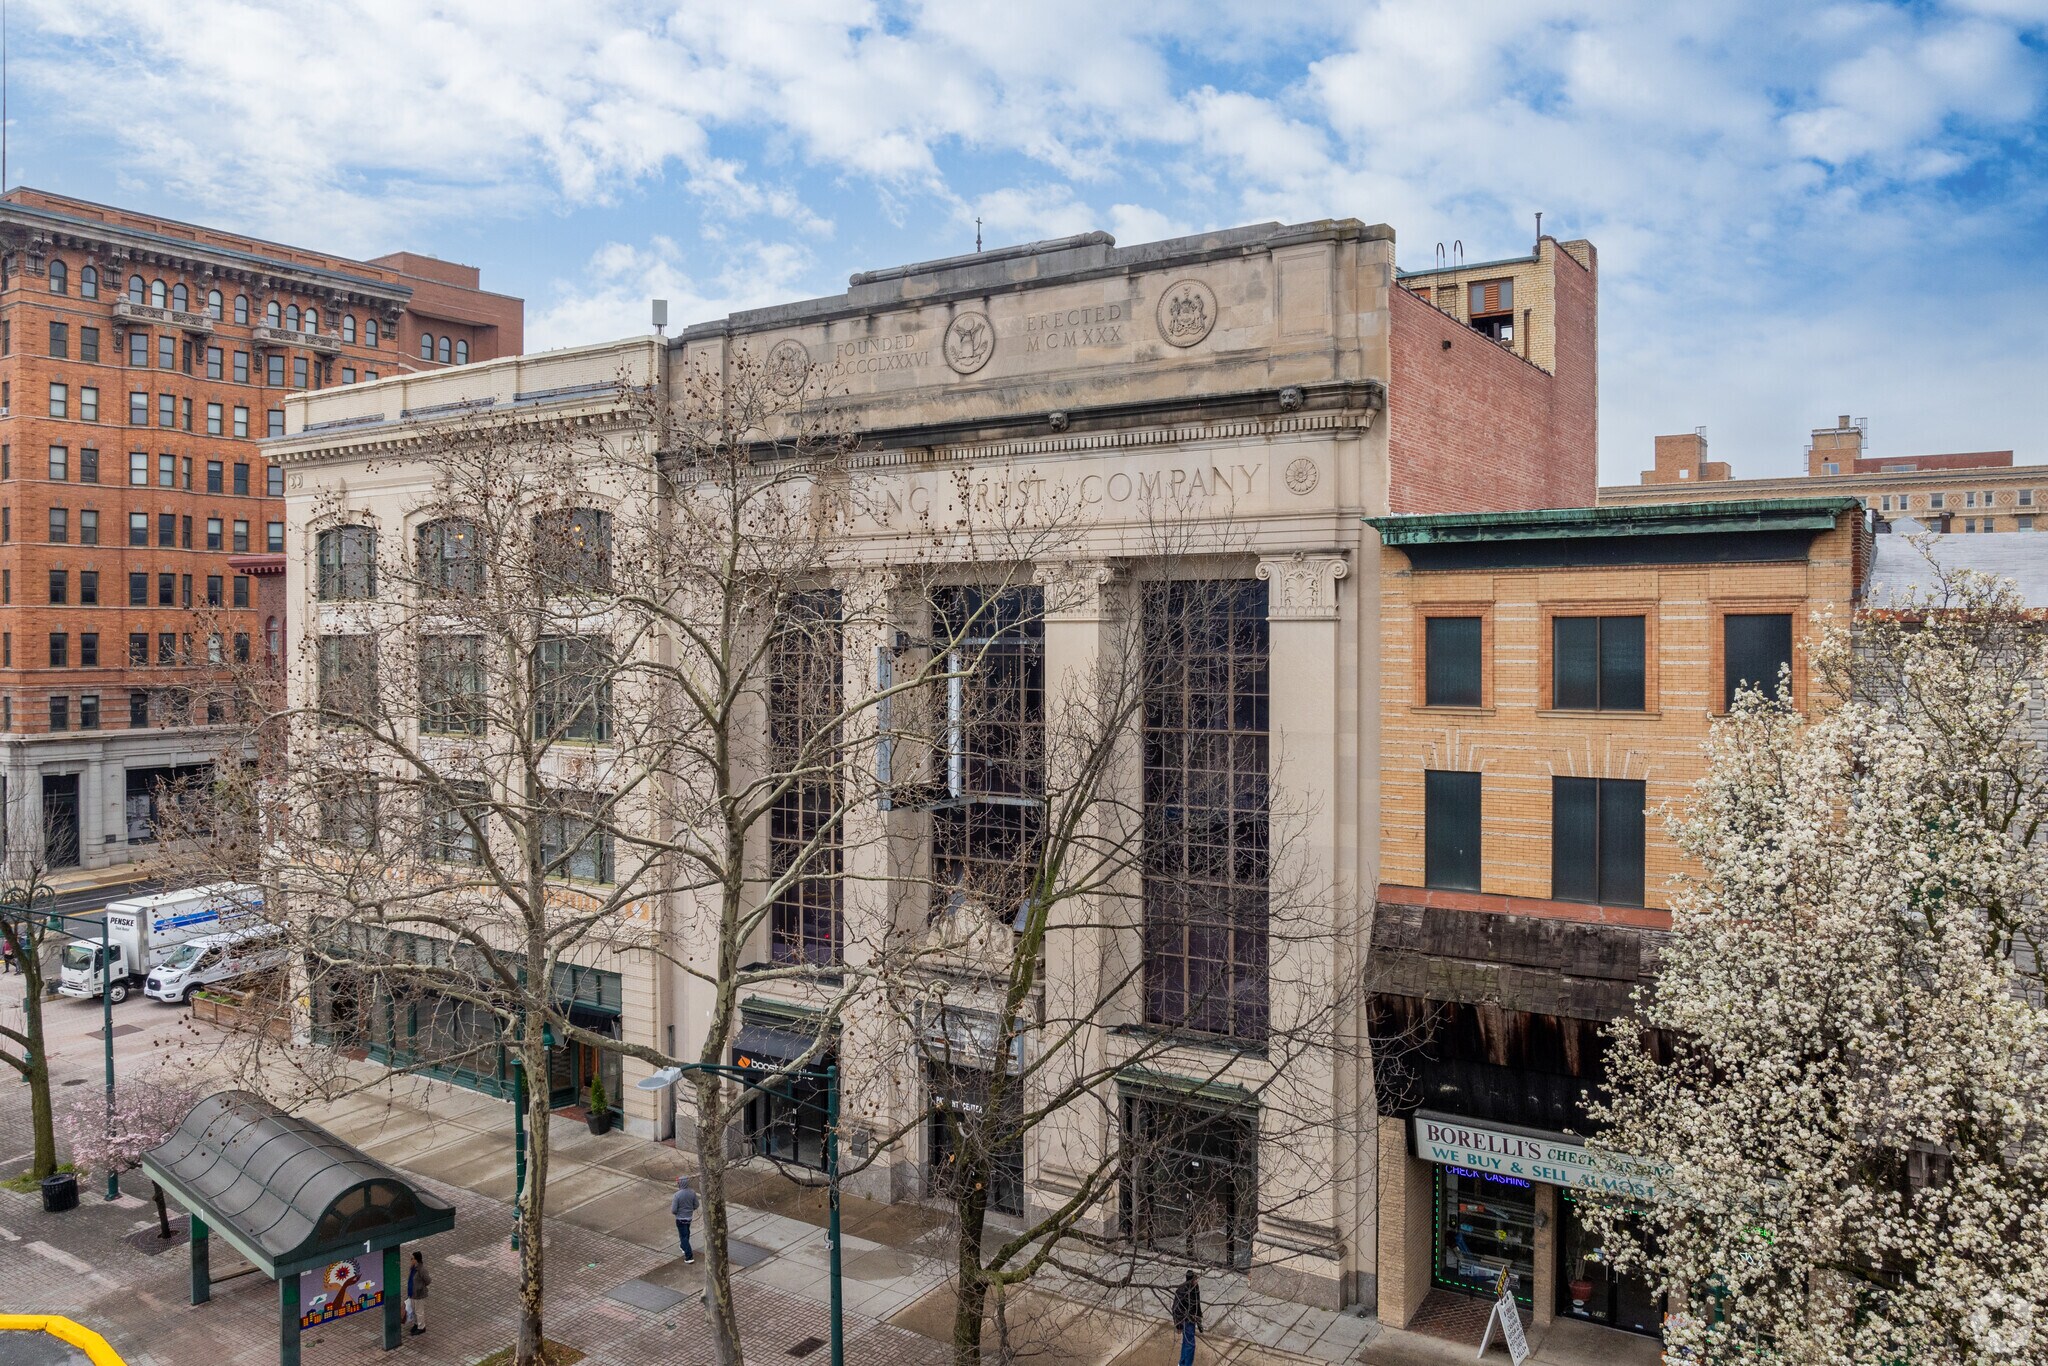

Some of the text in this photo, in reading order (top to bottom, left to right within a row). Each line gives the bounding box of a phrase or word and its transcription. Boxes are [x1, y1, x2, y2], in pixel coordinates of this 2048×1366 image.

[1027, 304, 1122, 332] ERECTED
[836, 334, 915, 358] FOUNDED
[1027, 325, 1122, 352] MCMXXX
[824, 351, 929, 379] MDCCCLXXXVI
[955, 478, 1047, 512] TRUST
[1079, 463, 1262, 504] COMPANY
[110, 916, 135, 927] PENSKE
[751, 1058, 779, 1071] boost
[1427, 1124, 1542, 1160] BORELLI'S
[1547, 1148, 1597, 1166] CHECK
[1432, 1147, 1460, 1162] WE
[1467, 1153, 1502, 1170] BUY
[1510, 1162, 1524, 1174] &
[1532, 1165, 1570, 1183] SELL
[1445, 1165, 1531, 1188] CHECK CASHING
[363, 1240, 371, 1253] 1
